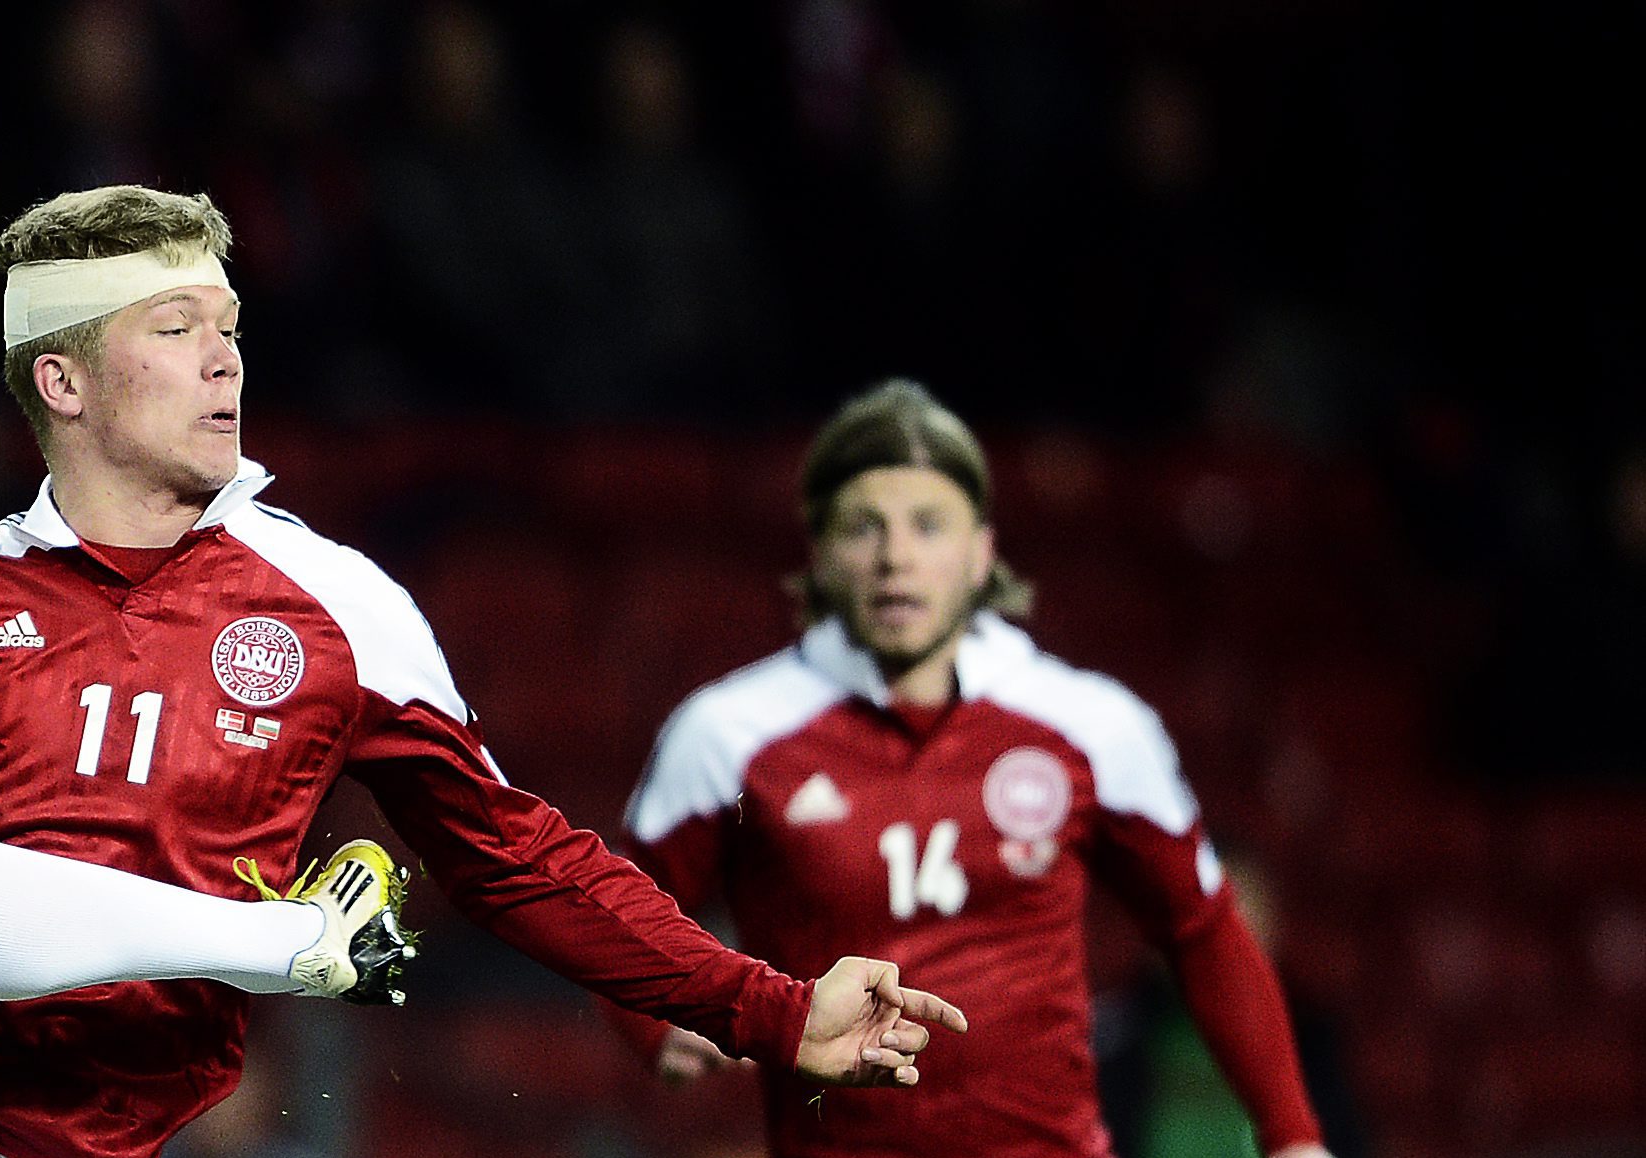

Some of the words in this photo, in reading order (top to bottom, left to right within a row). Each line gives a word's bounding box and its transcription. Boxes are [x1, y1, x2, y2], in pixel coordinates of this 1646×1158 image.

[217, 634, 235, 685] DANSK
[273, 652, 299, 695] UNION
[231, 643, 286, 676] DBU
[234, 684, 270, 701] 1889
[76, 682, 163, 785] 11
[878, 819, 969, 921] 14
